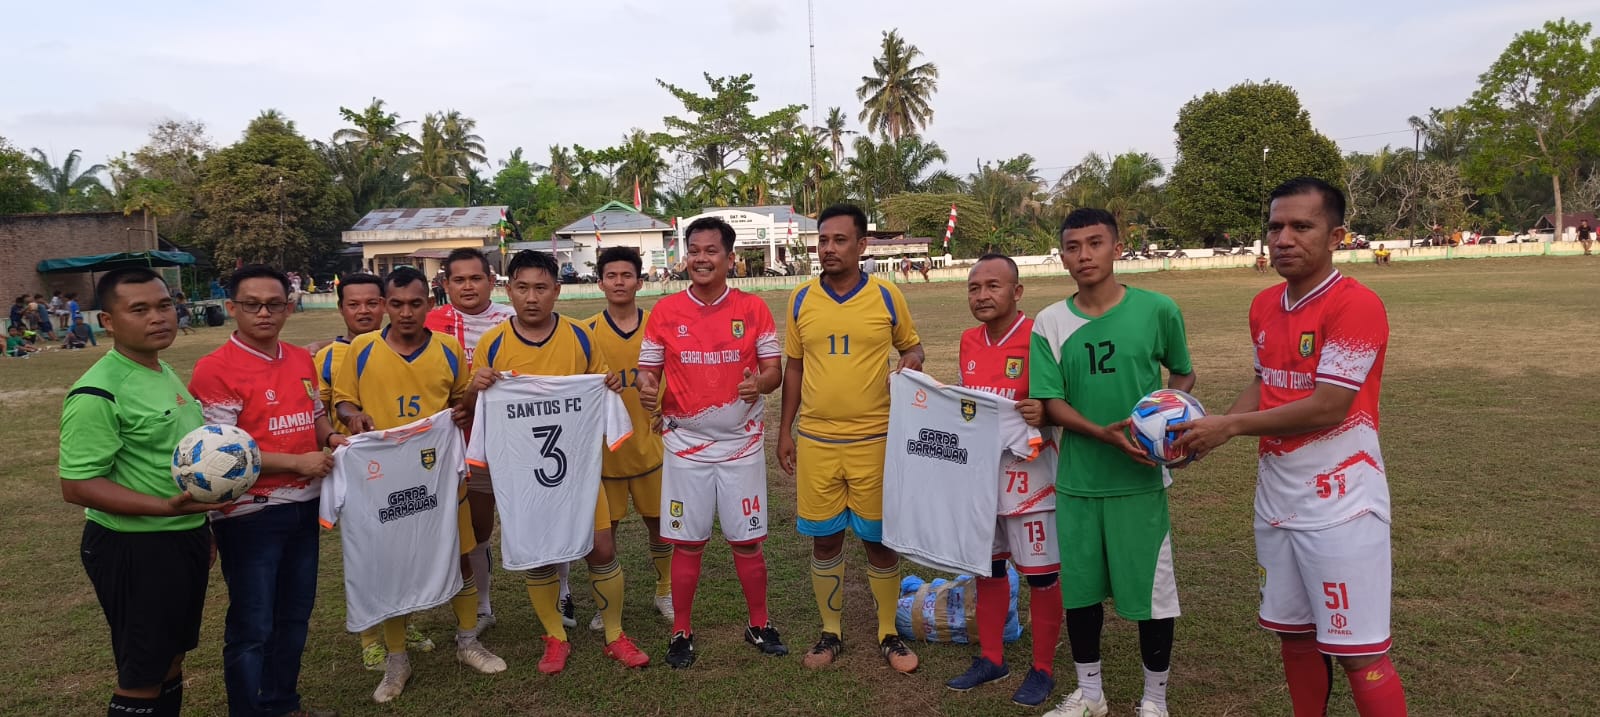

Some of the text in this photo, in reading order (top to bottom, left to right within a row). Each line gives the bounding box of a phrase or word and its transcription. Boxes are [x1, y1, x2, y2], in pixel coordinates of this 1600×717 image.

[827, 334, 851, 355] 11
[680, 349, 741, 364] SERGAI MAJU TERUS
[1084, 340, 1116, 375] 12
[618, 368, 639, 388] 12
[1289, 371, 1314, 390] TERUS
[964, 385, 1016, 400] BAAN
[397, 395, 421, 418] 15
[506, 397, 582, 419] SANTOS FC
[918, 427, 959, 448] GARDA
[532, 424, 568, 488] 3
[907, 439, 968, 464] DARMAWAN
[1005, 470, 1029, 494] 73
[1315, 473, 1346, 500] 51
[388, 485, 428, 506] GARDA
[741, 495, 761, 516] 04
[378, 493, 438, 524] DARMAWAN
[1023, 520, 1046, 543] 73
[1322, 581, 1349, 610] 51
